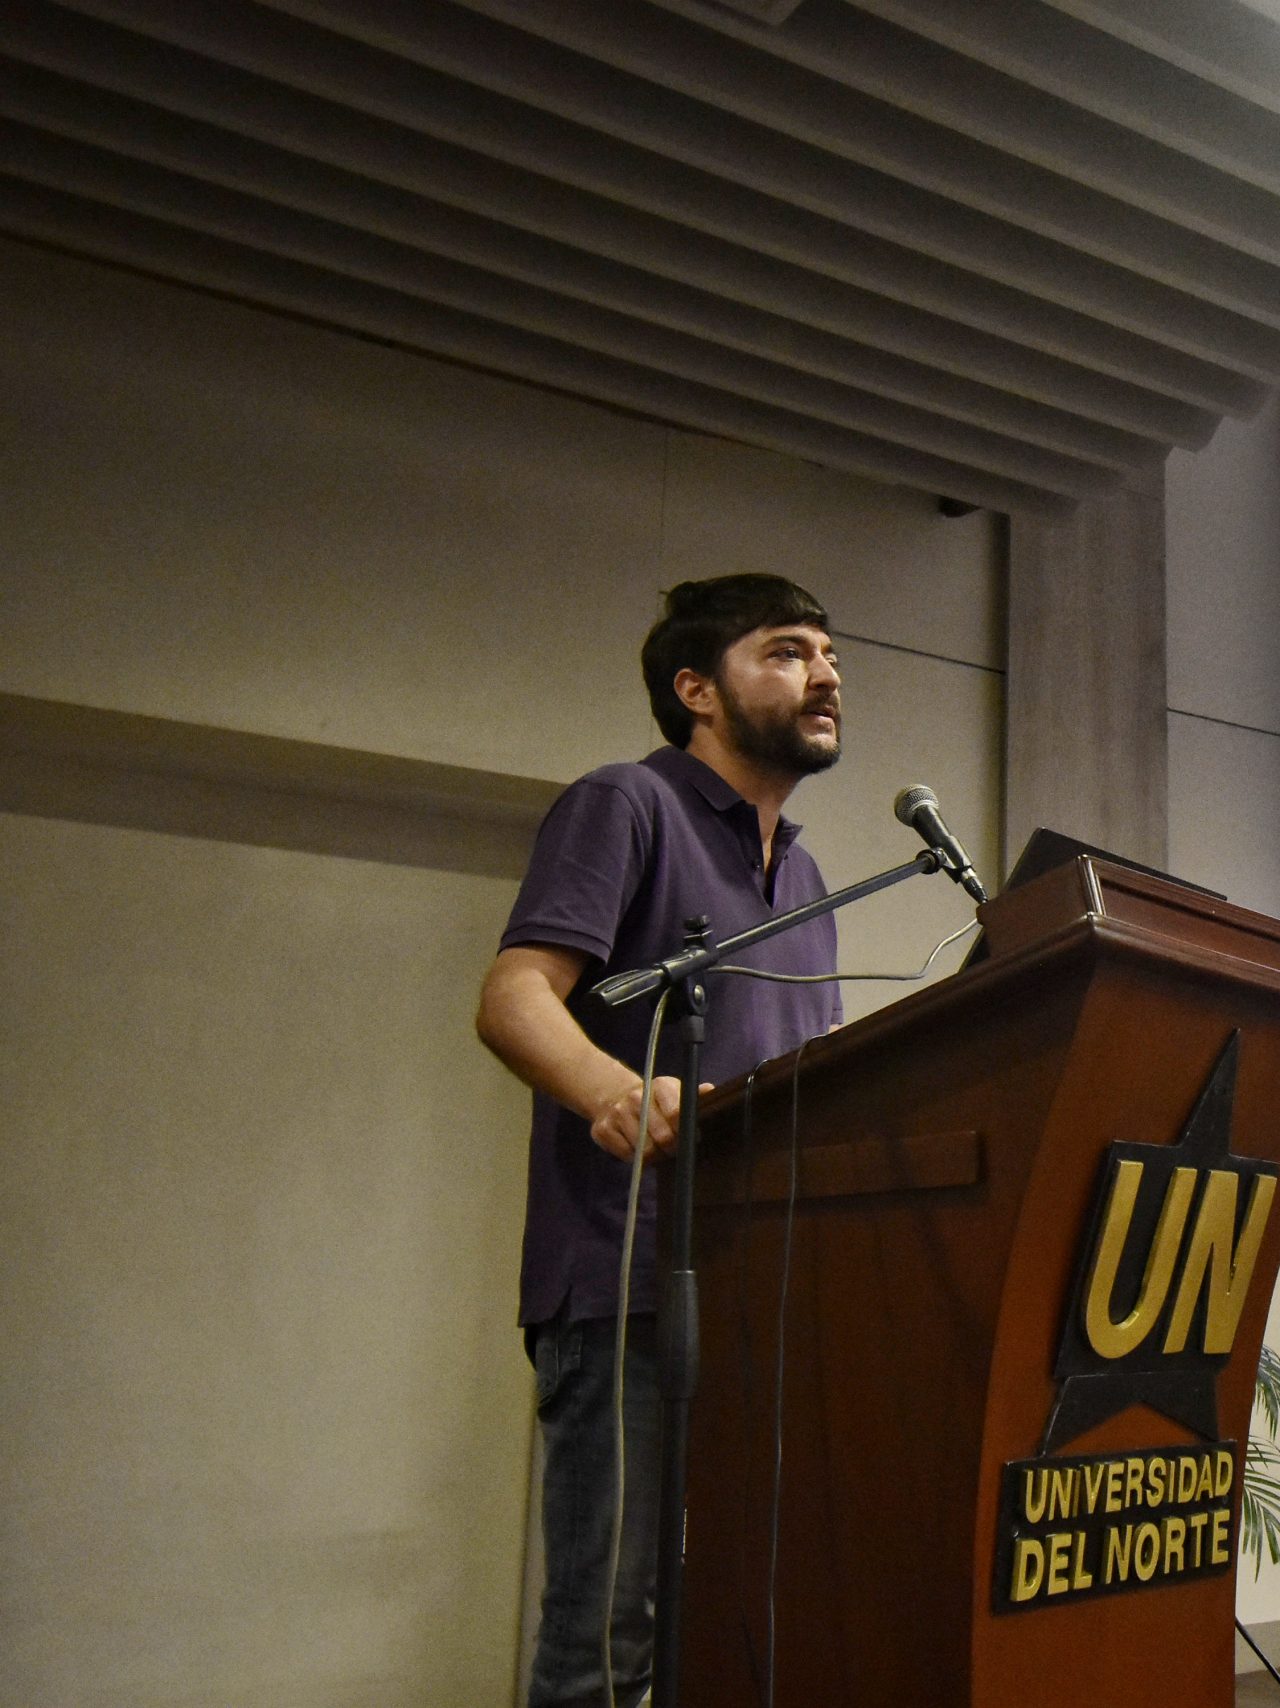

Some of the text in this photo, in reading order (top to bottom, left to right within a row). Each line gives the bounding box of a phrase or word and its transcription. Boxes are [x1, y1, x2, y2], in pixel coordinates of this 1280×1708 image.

[1085, 1159, 1277, 1359] UN
[1023, 1450, 1234, 1525] UNIVERSIDAD
[1010, 1509, 1230, 1602] DEL NORTE
